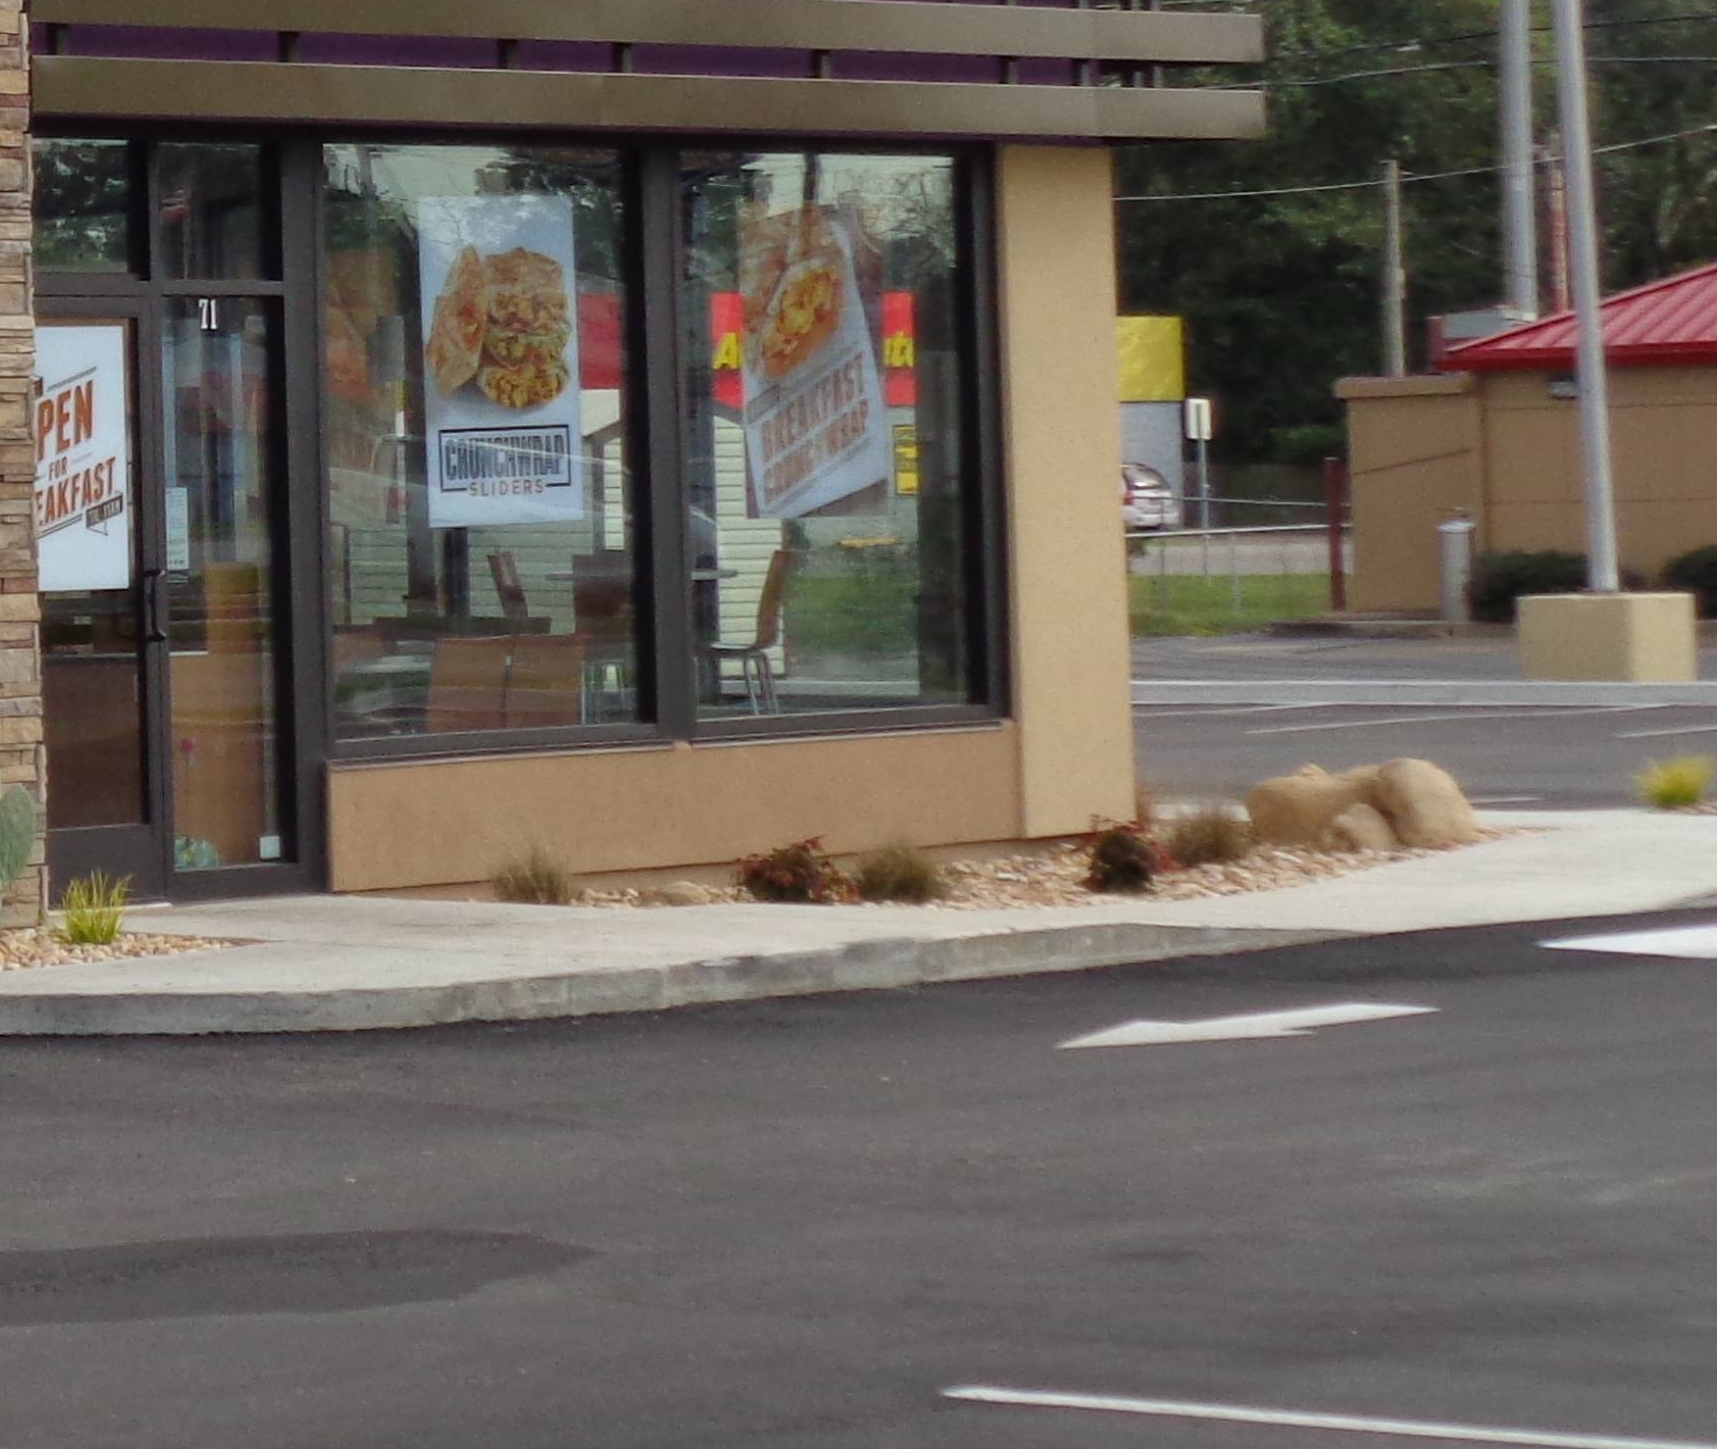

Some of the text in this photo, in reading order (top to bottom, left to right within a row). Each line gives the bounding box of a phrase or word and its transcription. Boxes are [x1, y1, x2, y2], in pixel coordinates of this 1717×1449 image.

[198, 298, 218, 330] 71
[37, 379, 94, 462] PEN
[761, 351, 864, 464] BREAKFAST
[49, 456, 68, 482] FOR
[445, 435, 565, 481] CRUNCHWRAP
[35, 456, 116, 527] EAKFAST
[469, 478, 545, 497] SLIDERS
